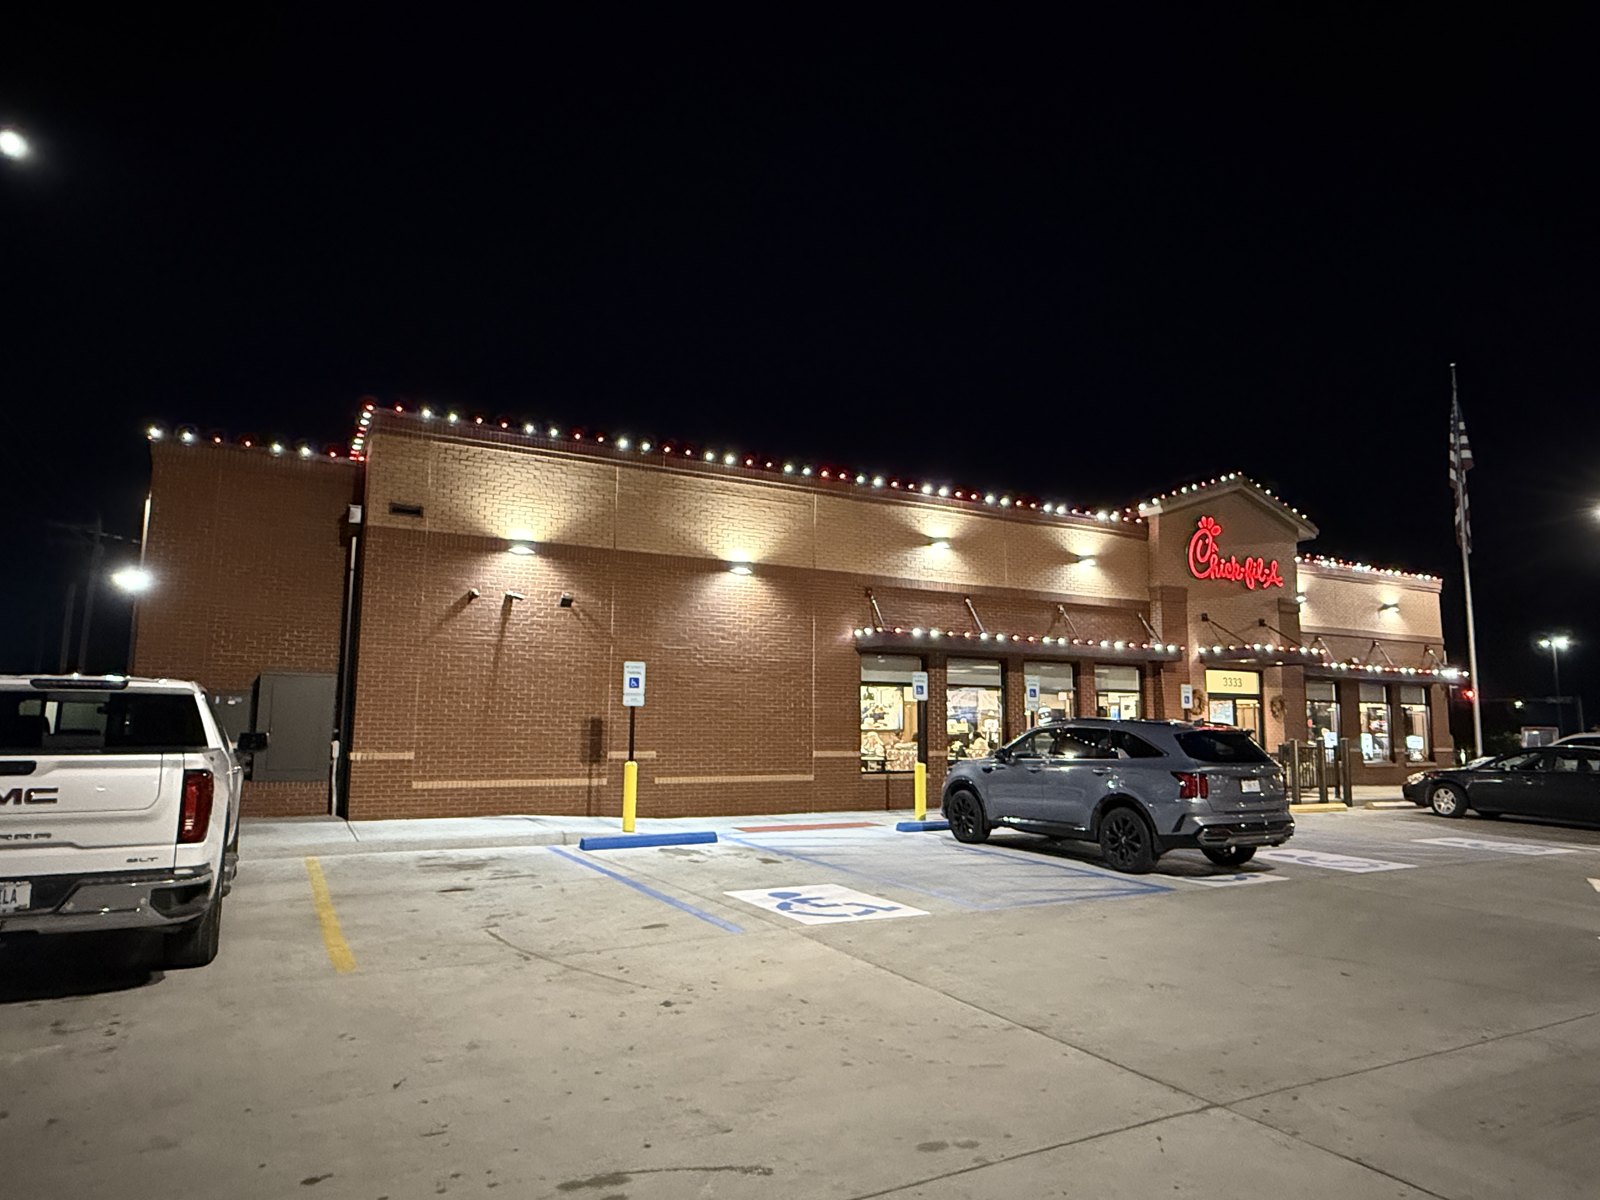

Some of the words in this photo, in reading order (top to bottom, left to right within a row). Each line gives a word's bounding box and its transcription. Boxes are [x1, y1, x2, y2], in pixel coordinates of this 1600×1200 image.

[1188, 516, 1284, 590] Chick-fil-A
[1222, 676, 1243, 688] 3333
[0, 888, 17, 905] LA
